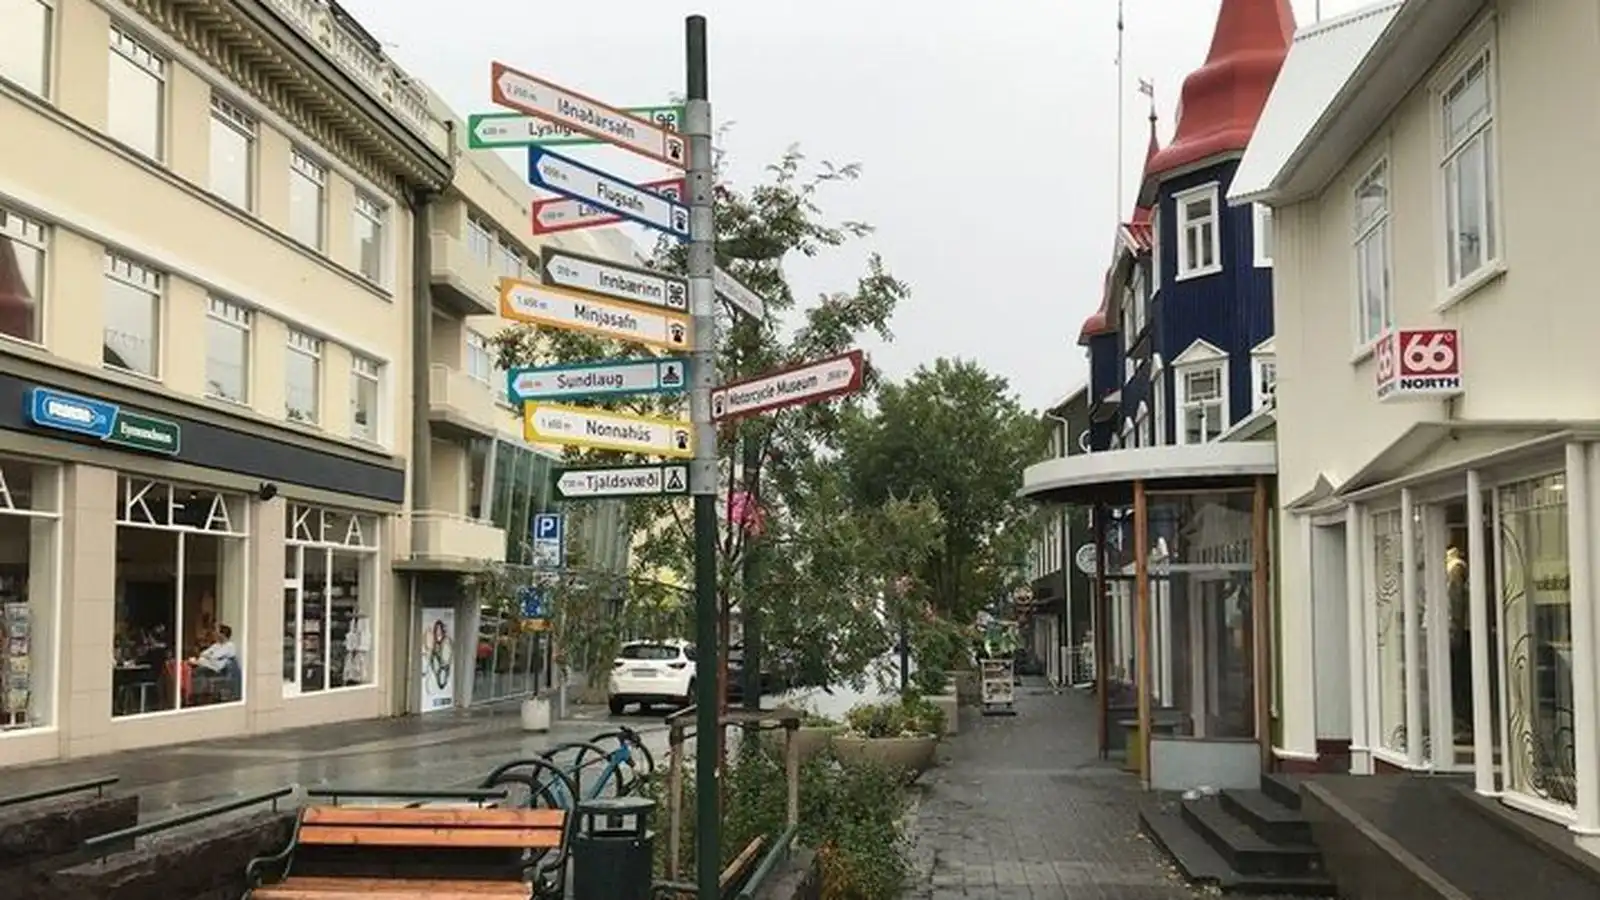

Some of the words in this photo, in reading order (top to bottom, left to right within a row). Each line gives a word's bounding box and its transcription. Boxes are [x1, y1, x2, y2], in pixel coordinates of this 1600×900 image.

[528, 122, 577, 137] Lystig
[557, 98, 635, 139] Iðnaðarsafn
[597, 182, 645, 212] Flugsafn
[599, 271, 662, 298] Innbærinn
[574, 303, 637, 330] Minjasafn
[557, 373, 624, 389] Sundlaug
[776, 375, 818, 393] Museum
[1401, 378, 1459, 389] NORTH
[586, 419, 651, 442] Nonnahús
[586, 468, 659, 492] Tjaldsvæði
[541, 517, 553, 536] P
